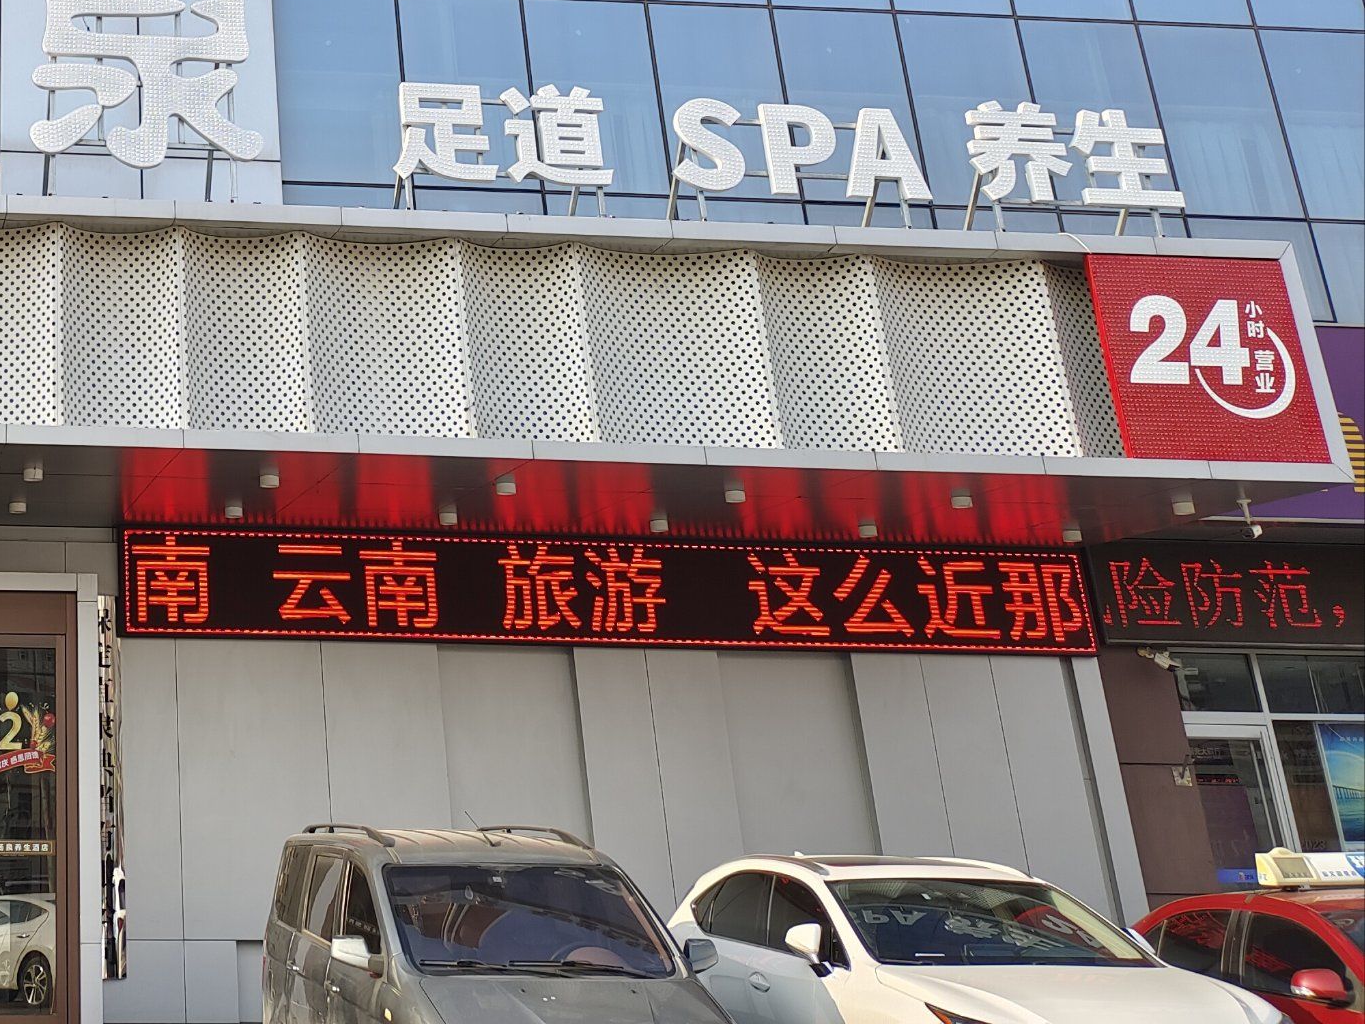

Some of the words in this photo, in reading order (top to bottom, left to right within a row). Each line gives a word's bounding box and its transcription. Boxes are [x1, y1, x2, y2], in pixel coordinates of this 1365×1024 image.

[393, 82, 614, 187] 足道
[674, 98, 933, 201] SPA
[964, 100, 1186, 208] 养生
[1130, 295, 1250, 385] 24
[132, 536, 211, 624] 南
[273, 539, 439, 628] 云南
[498, 543, 666, 632] 旅游
[747, 553, 1083, 643] 这么近那
